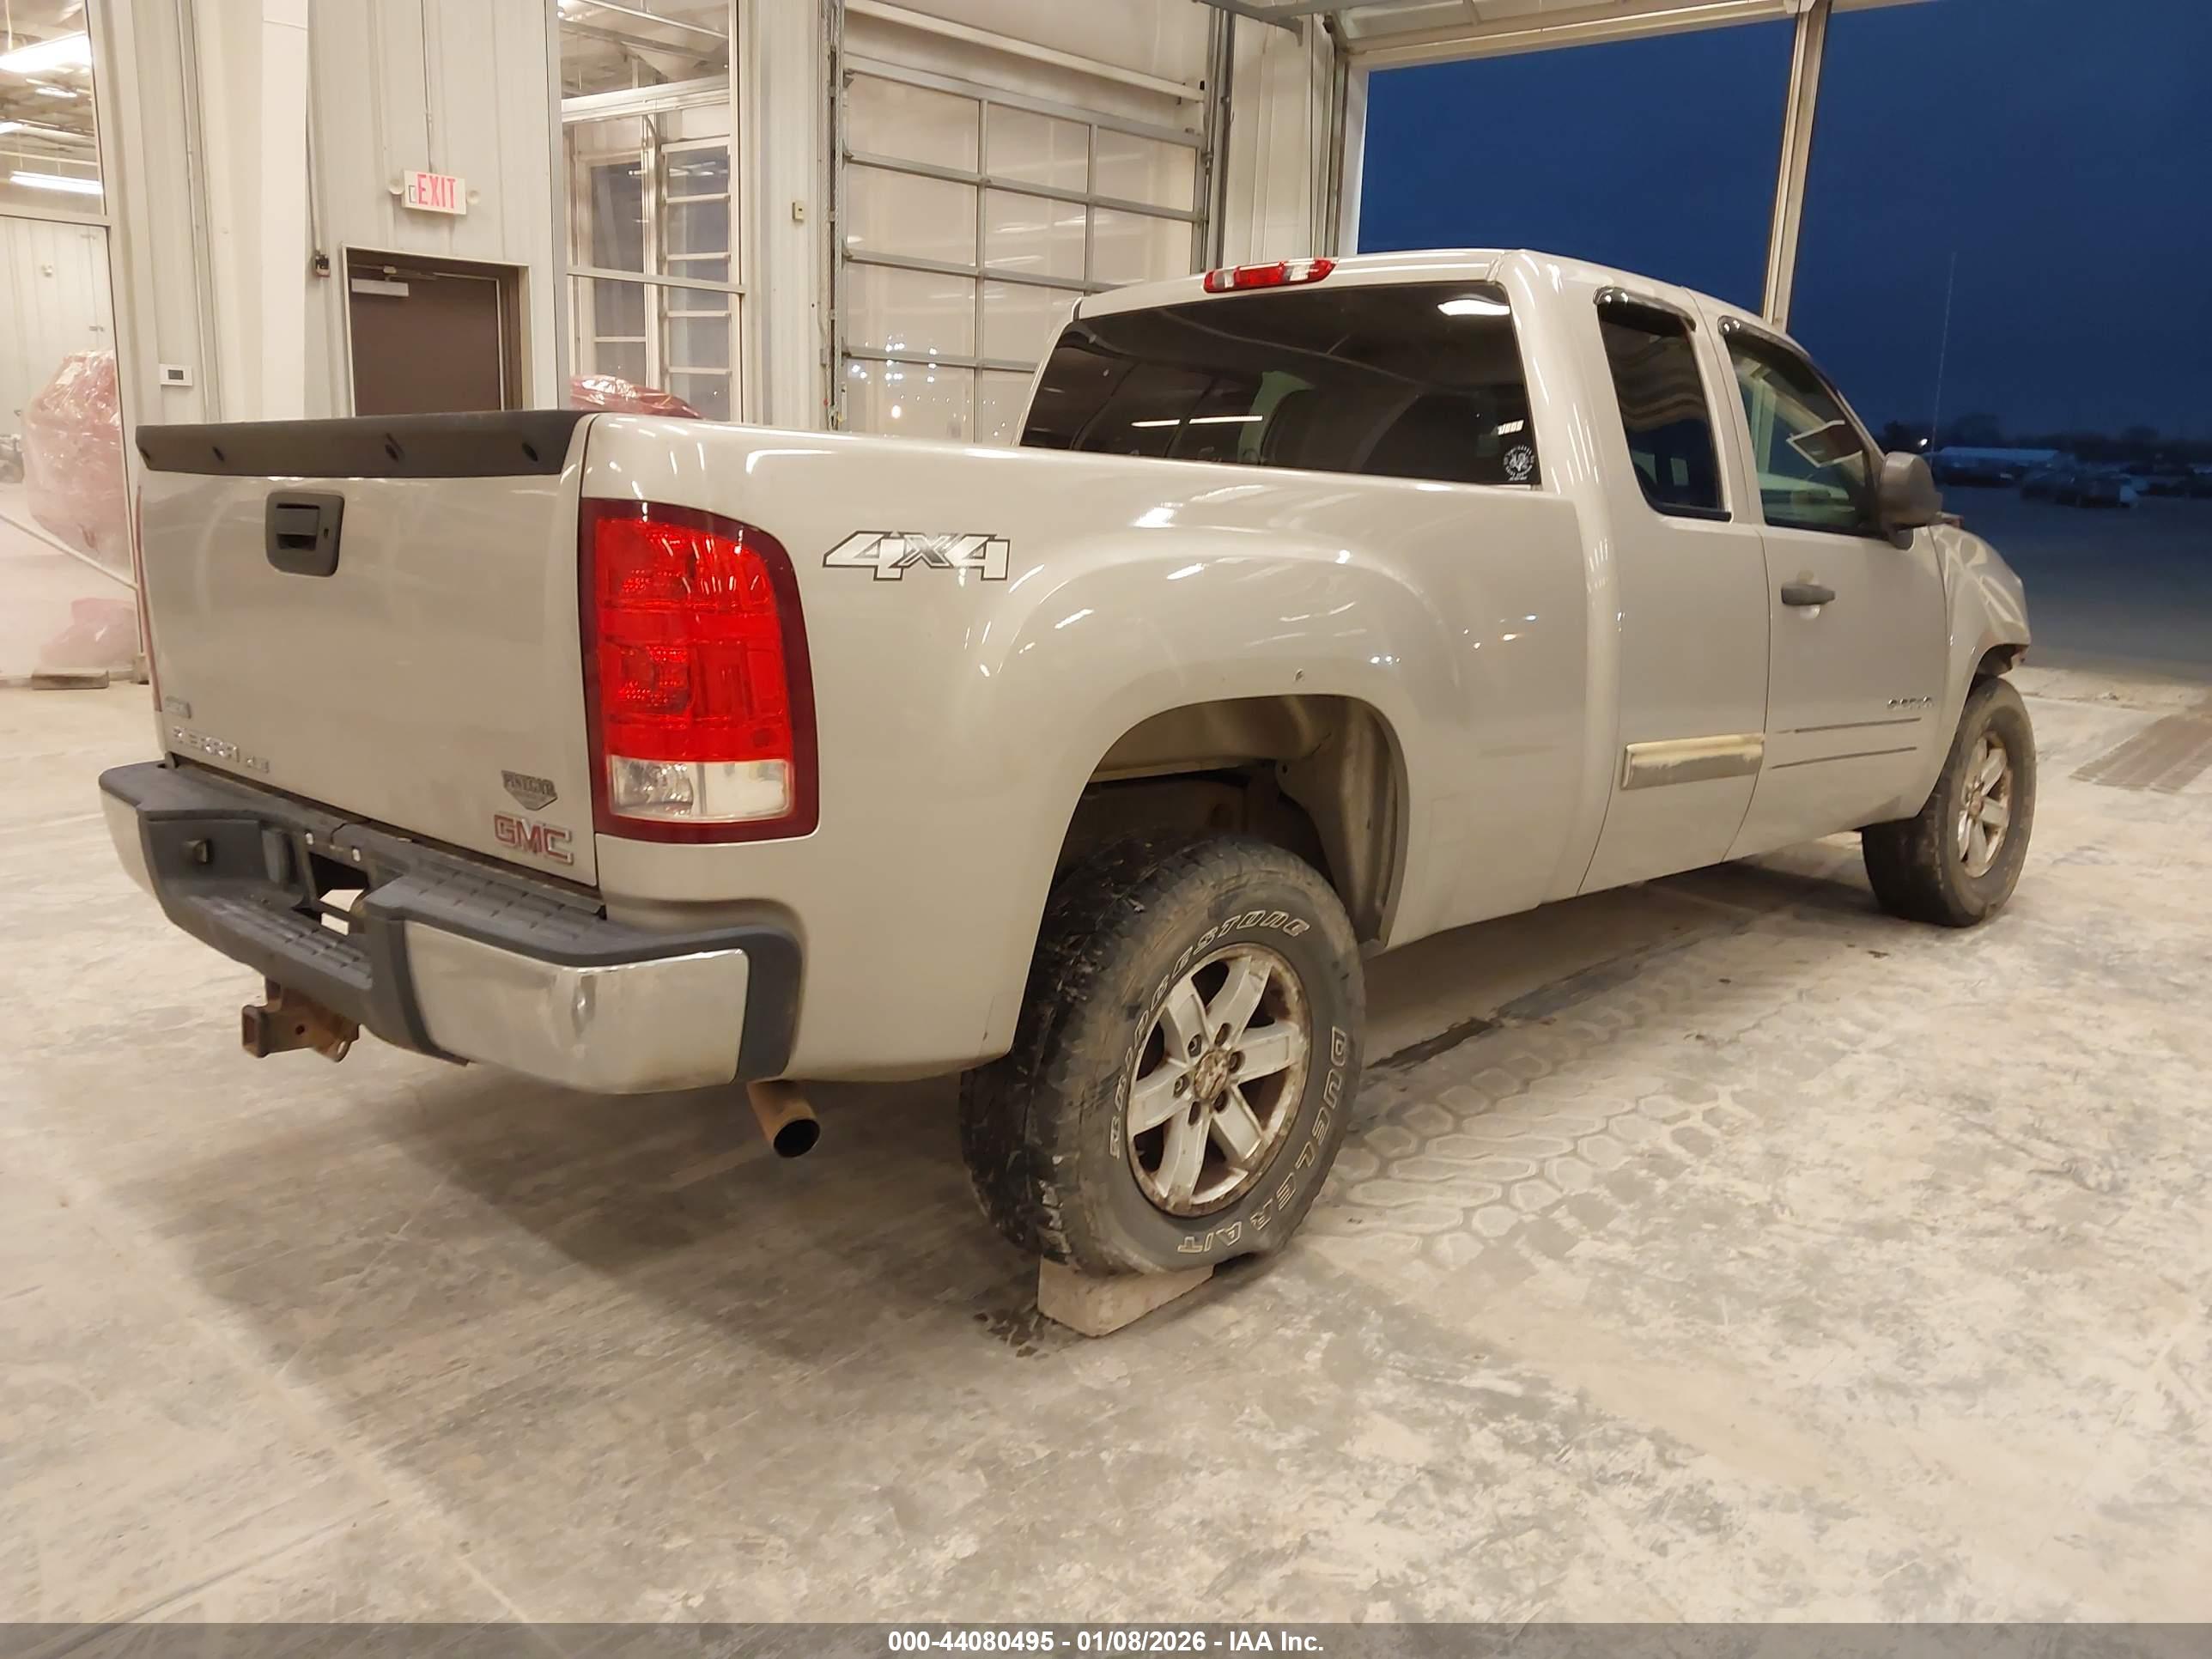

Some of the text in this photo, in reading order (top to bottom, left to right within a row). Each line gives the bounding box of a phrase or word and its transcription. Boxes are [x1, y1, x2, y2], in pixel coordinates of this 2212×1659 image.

[416, 173, 456, 209] EXIT
[494, 811, 574, 866] GMC
[1249, 1025, 1347, 1231] DUELER
